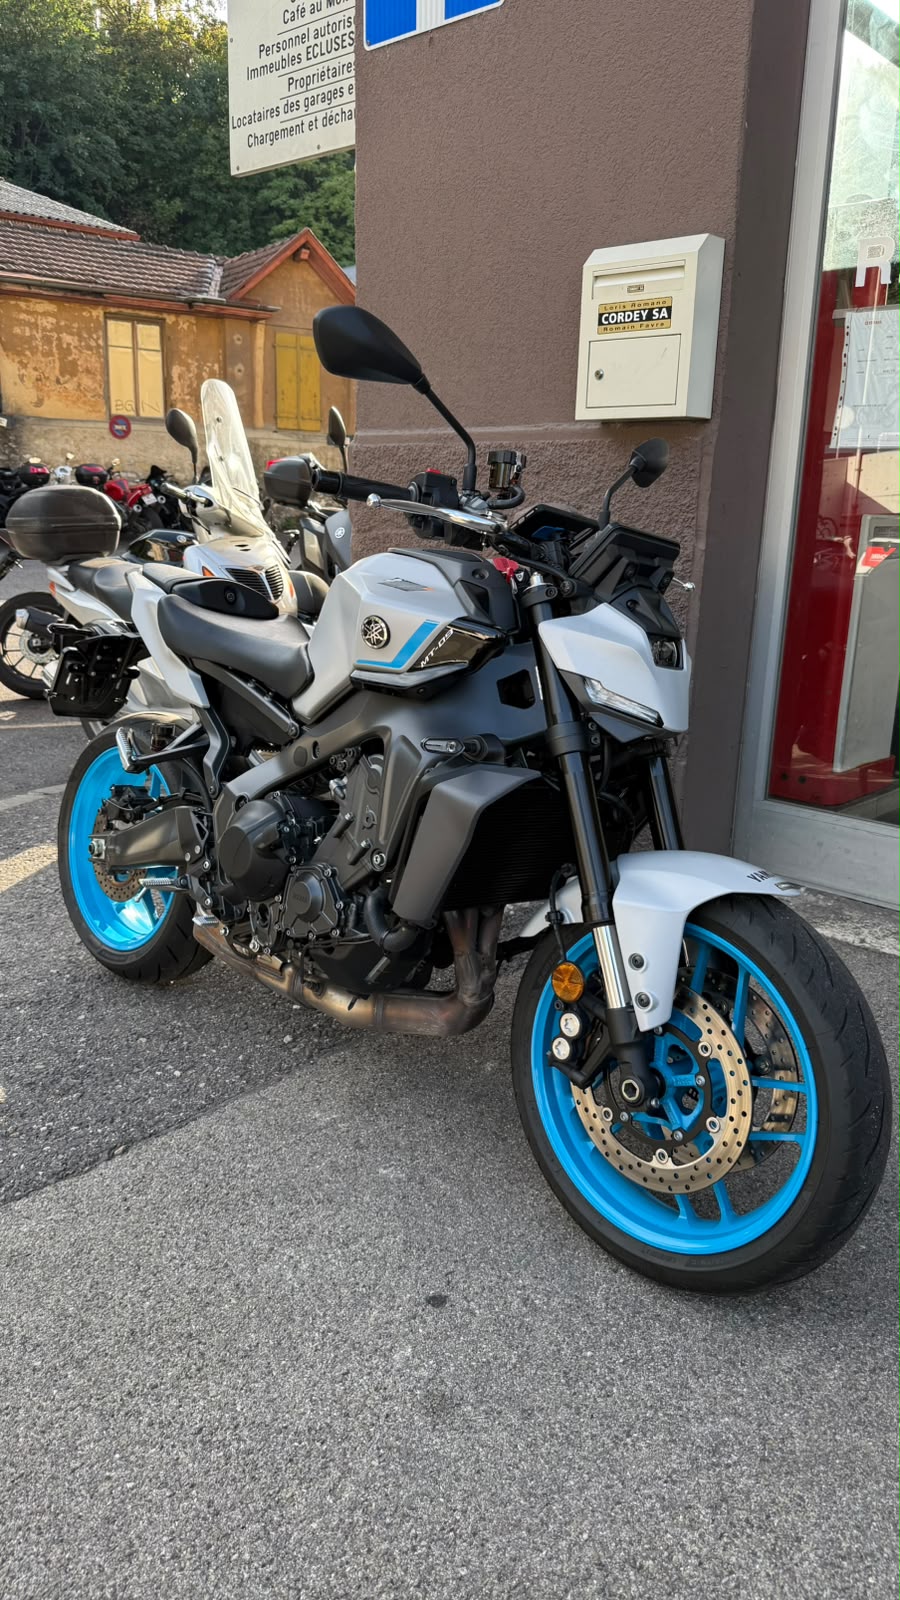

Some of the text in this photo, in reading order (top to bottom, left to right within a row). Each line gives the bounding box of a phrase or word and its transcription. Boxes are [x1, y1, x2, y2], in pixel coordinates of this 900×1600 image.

[282, 3, 306, 24] Café
[309, 0, 323, 15] au
[246, 30, 355, 80] Immeubles ECLUSES
[259, 14, 355, 59] Personnel autoris
[231, 106, 280, 129] Locataires
[283, 99, 301, 115] des
[304, 86, 344, 112] garages
[247, 107, 355, 148] Chargement et décha
[855, 236, 895, 287] R
[601, 308, 668, 325] CORDEY SA
[604, 300, 667, 311] Loris Romano
[420, 627, 453, 668] MT-09
